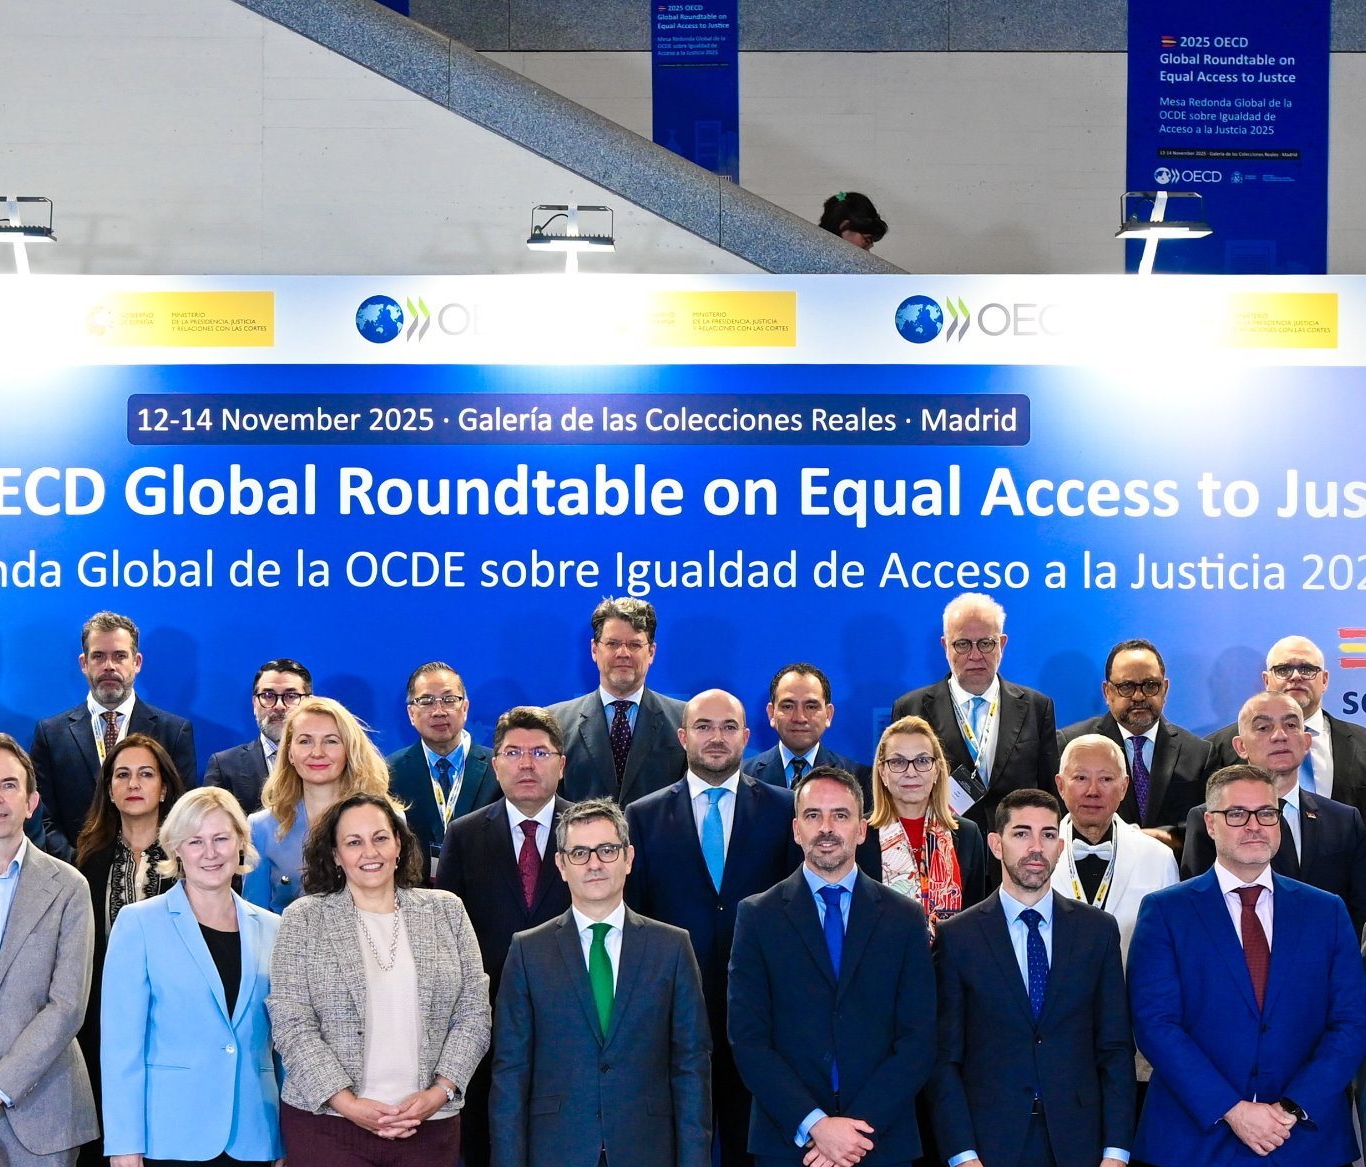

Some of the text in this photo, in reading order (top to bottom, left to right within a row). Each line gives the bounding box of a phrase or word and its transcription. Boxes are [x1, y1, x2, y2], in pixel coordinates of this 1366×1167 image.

[1180, 36, 1248, 48] 2025 OECD
[1160, 53, 1295, 65] Global Roundtable on
[1160, 70, 1193, 84] Equal
[1197, 71, 1238, 82] Access
[1241, 73, 1255, 82] to
[1160, 97, 1292, 108] Mesa Redonda Global de la
[1159, 110, 1276, 123] OCDE sobre Igualdad de
[1159, 124, 1193, 134] Acceso
[1204, 125, 1212, 134] la
[1250, 125, 1274, 135] 2025
[1181, 170, 1222, 183] OECD
[978, 303, 1065, 336] OEC
[139, 407, 1016, 432] 12-14 November 2025 Galería de las Colecciones Reales Madrid
[124, 465, 317, 517] Global
[339, 465, 684, 517] Roundtable
[704, 478, 778, 516] on
[801, 464, 961, 529] Equal
[980, 465, 1180, 517] Access
[1201, 470, 1260, 517] to
[77, 549, 214, 588] Global
[230, 549, 282, 588] de
[296, 549, 330, 588] la
[346, 551, 465, 588] OCDE
[479, 549, 598, 588] sobre
[616, 549, 798, 600] Igualdad
[813, 549, 864, 588] de
[879, 549, 1029, 588] Acceso
[1045, 561, 1064, 588] a
[1084, 550, 1117, 589] la
[1132, 551, 1286, 590] Justicia
